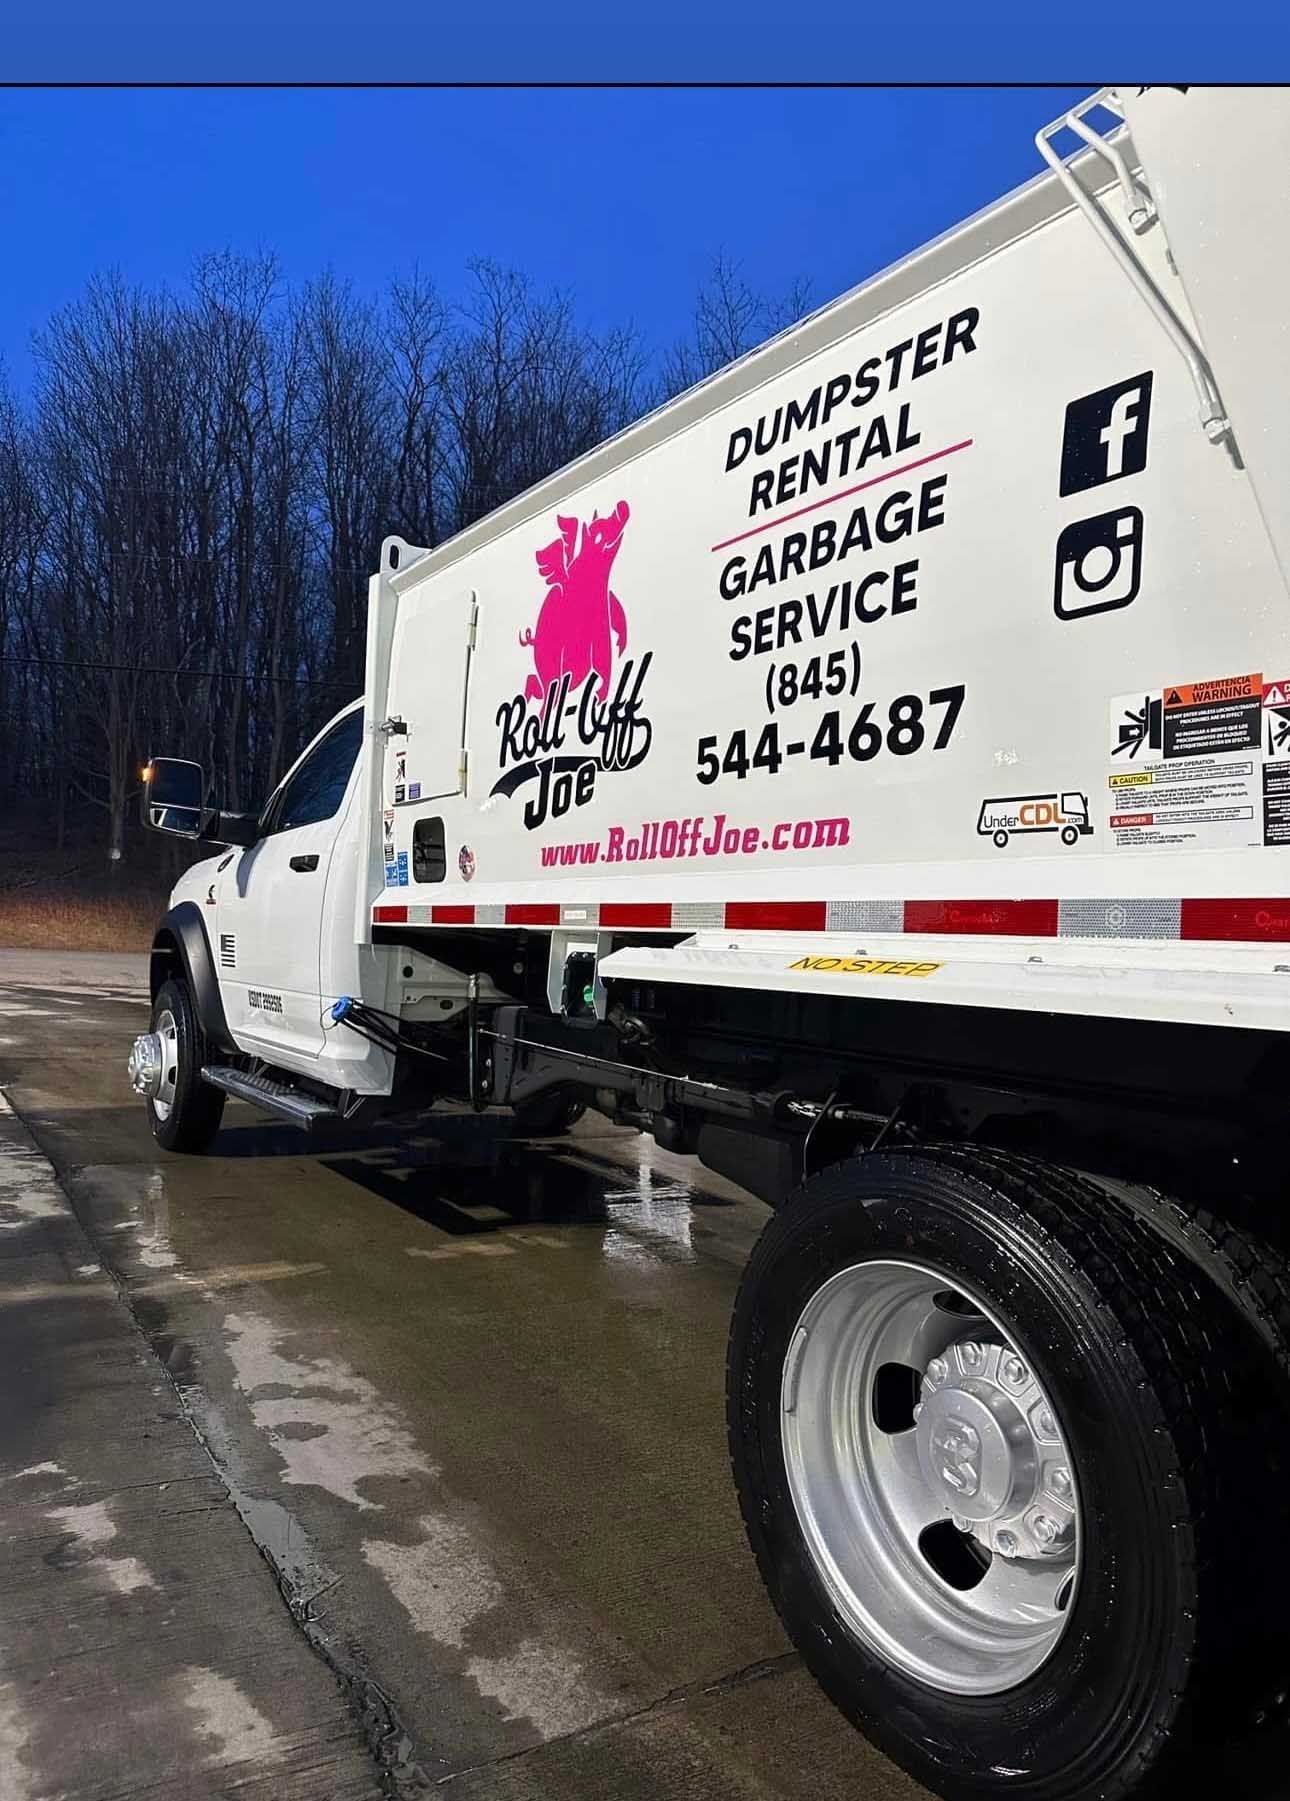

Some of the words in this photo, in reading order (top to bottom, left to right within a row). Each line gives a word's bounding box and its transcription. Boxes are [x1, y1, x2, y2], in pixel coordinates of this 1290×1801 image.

[725, 307, 980, 473] DUMPSTER
[749, 403, 921, 516] RENTAL
[719, 474, 947, 600] GARBAGE
[729, 559, 919, 661] SERVICE
[496, 651, 653, 770] Roll-Off
[766, 641, 861, 713] (845)
[1192, 685, 1251, 703] WARNING
[1193, 676, 1250, 692] ADVERTENCIA
[696, 685, 966, 785] 544-4687
[1184, 759, 1215, 767] OPERATION
[524, 757, 596, 831] Joe
[1119, 775, 1148, 784] CAUTION
[541, 816, 850, 867] www.RollOffJoe.com
[1120, 816, 1147, 824] DANGER
[790, 957, 841, 970] NO
[843, 959, 940, 976] STEP
